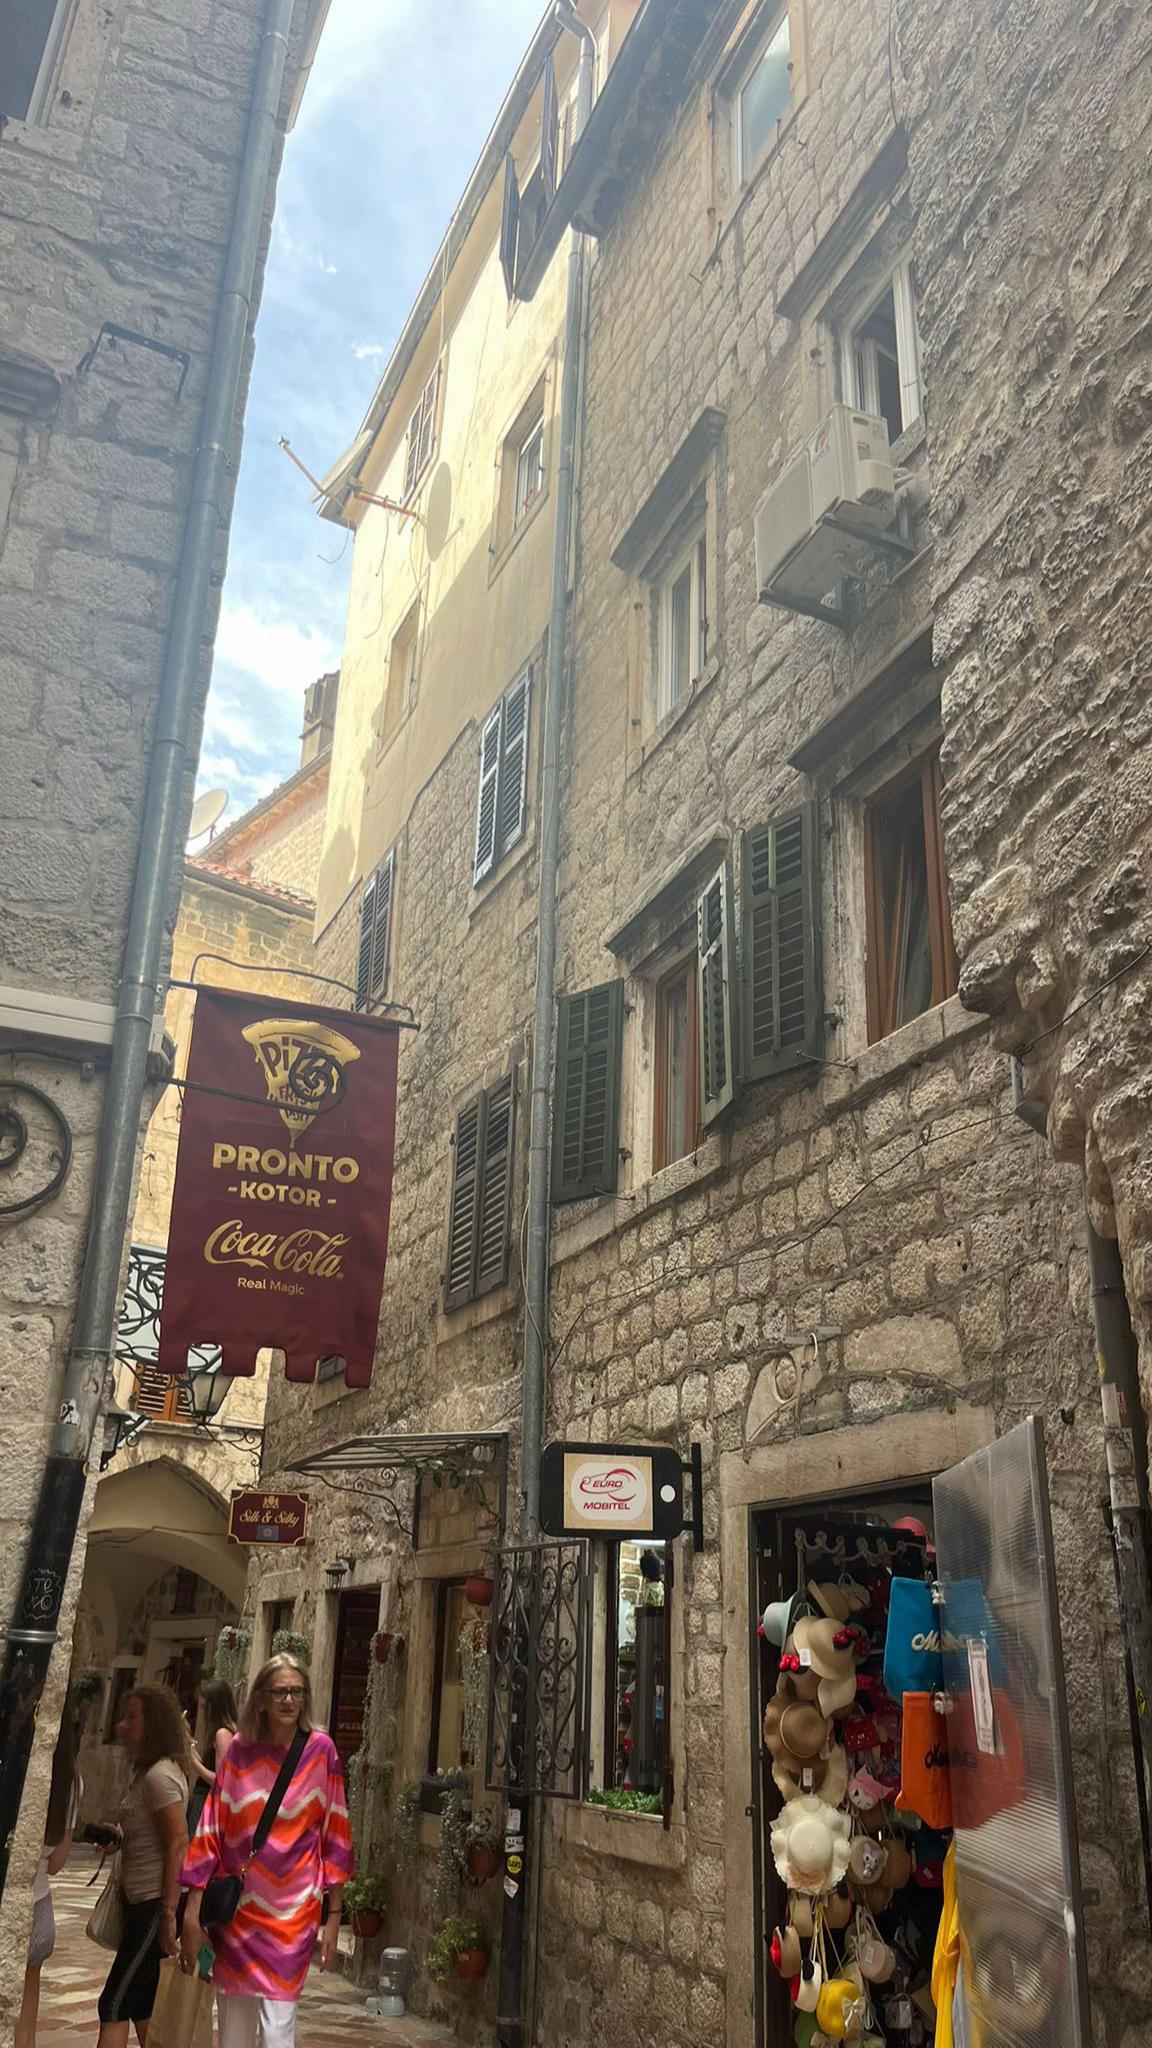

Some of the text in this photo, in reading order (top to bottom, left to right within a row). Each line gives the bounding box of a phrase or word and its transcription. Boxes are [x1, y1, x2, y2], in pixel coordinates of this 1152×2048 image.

[212, 1142, 360, 1184] PRONTO
[237, 1277, 305, 1296] Real Magic
[592, 1480, 623, 1488] EURO
[582, 1502, 631, 1511] MOBITEL
[239, 1508, 300, 1528] Silk & Silky
